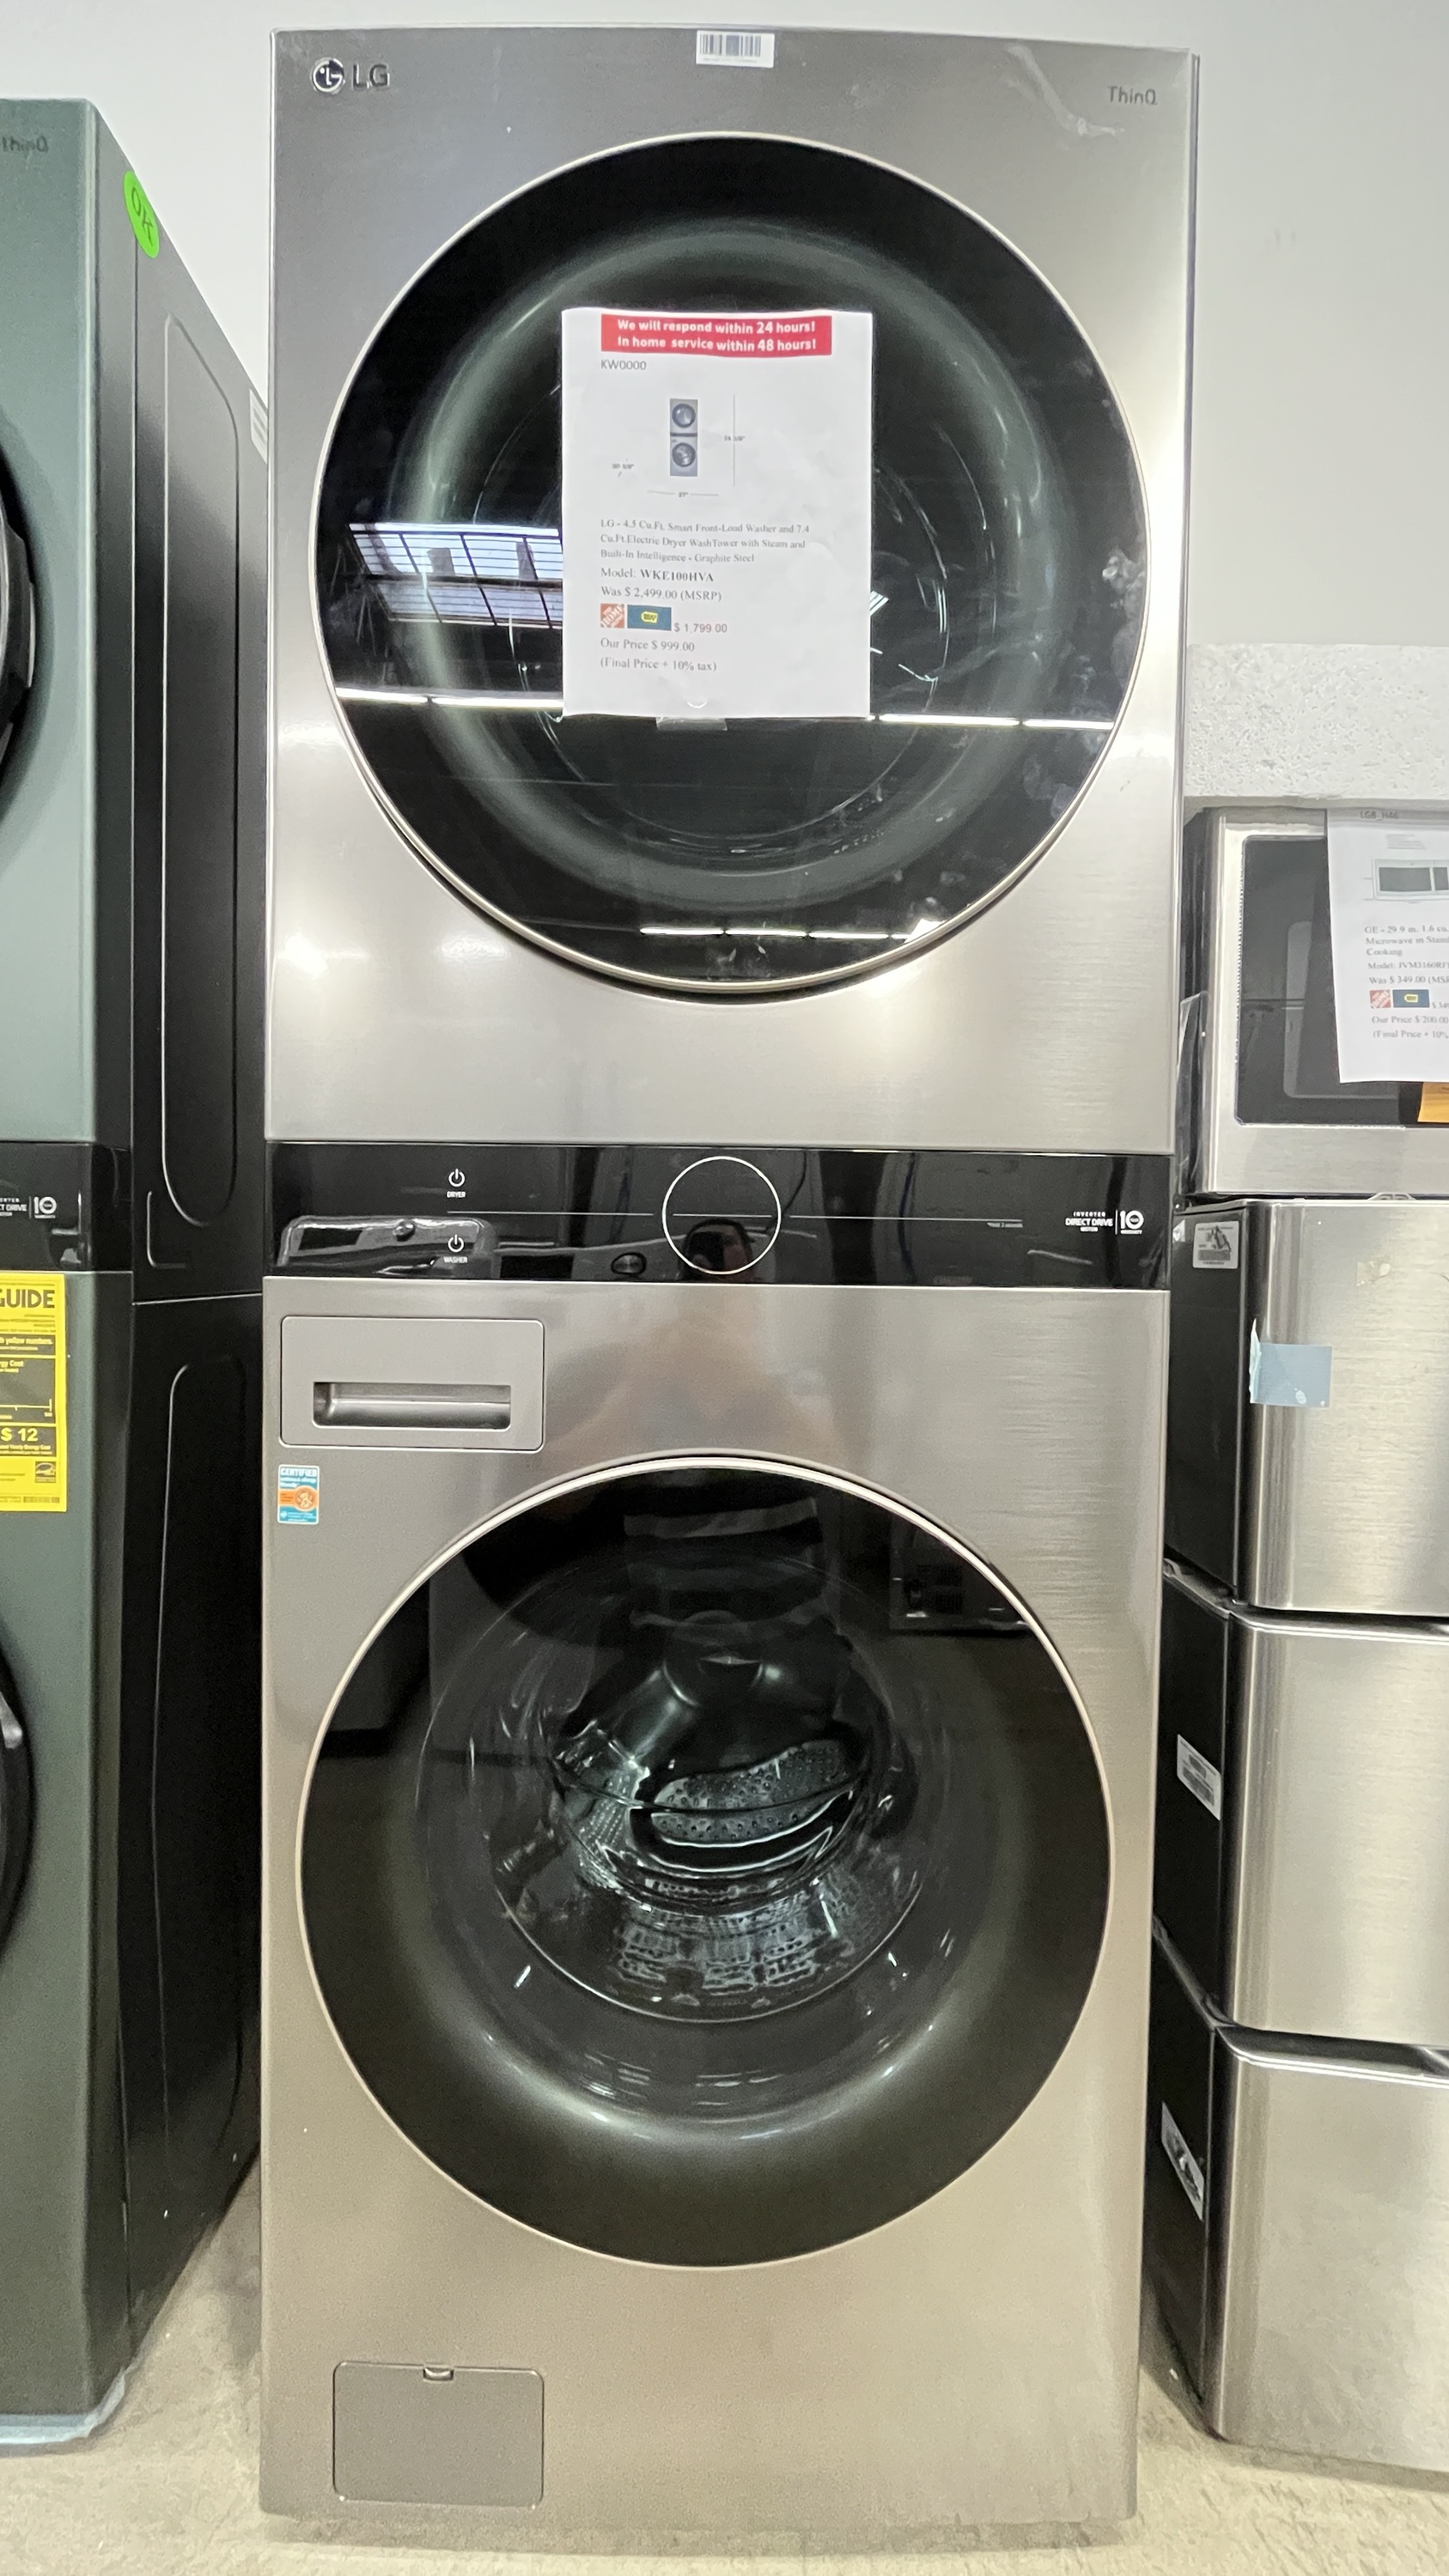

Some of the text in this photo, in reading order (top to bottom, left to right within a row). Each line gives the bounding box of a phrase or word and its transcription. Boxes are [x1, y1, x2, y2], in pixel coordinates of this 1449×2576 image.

[352, 64, 390, 88] LG
[1107, 85, 1158, 106] ThinQ
[618, 319, 815, 334] We will respond within 24 hours!
[618, 336, 816, 351] In home service within 48 hours!
[600, 519, 615, 528] LG
[667, 522, 692, 532] Smart
[696, 524, 743, 532] Front-Load
[746, 524, 776, 533] Washer
[778, 525, 795, 533] and
[796, 525, 810, 533] 7.4
[662, 538, 686, 549] Dryer
[740, 539, 759, 548] with
[762, 539, 788, 549] Steam
[790, 540, 806, 549] and
[636, 550, 686, 563] Intelligence
[694, 554, 732, 564] Graphite
[734, 554, 755, 562] Steel
[600, 567, 714, 582] Model: WKE100HVA
[600, 586, 722, 601] Was $ 2,499.00 (MSRP)
[674, 622, 728, 634] $ 1,799.00
[600, 637, 695, 652] Our Price $ 999.00
[600, 656, 630, 669] (Final
[633, 658, 659, 669] Price
[673, 659, 695, 671] 10%
[697, 661, 717, 672] tax)
[1366, 937, 1413, 945] Microwave
[1369, 976, 1387, 985] Was
[1401, 1030, 1422, 1038] Price
[1065, 1218, 1113, 1227] DIRECT DRIVE
[17, 1427, 39, 1442] 12
